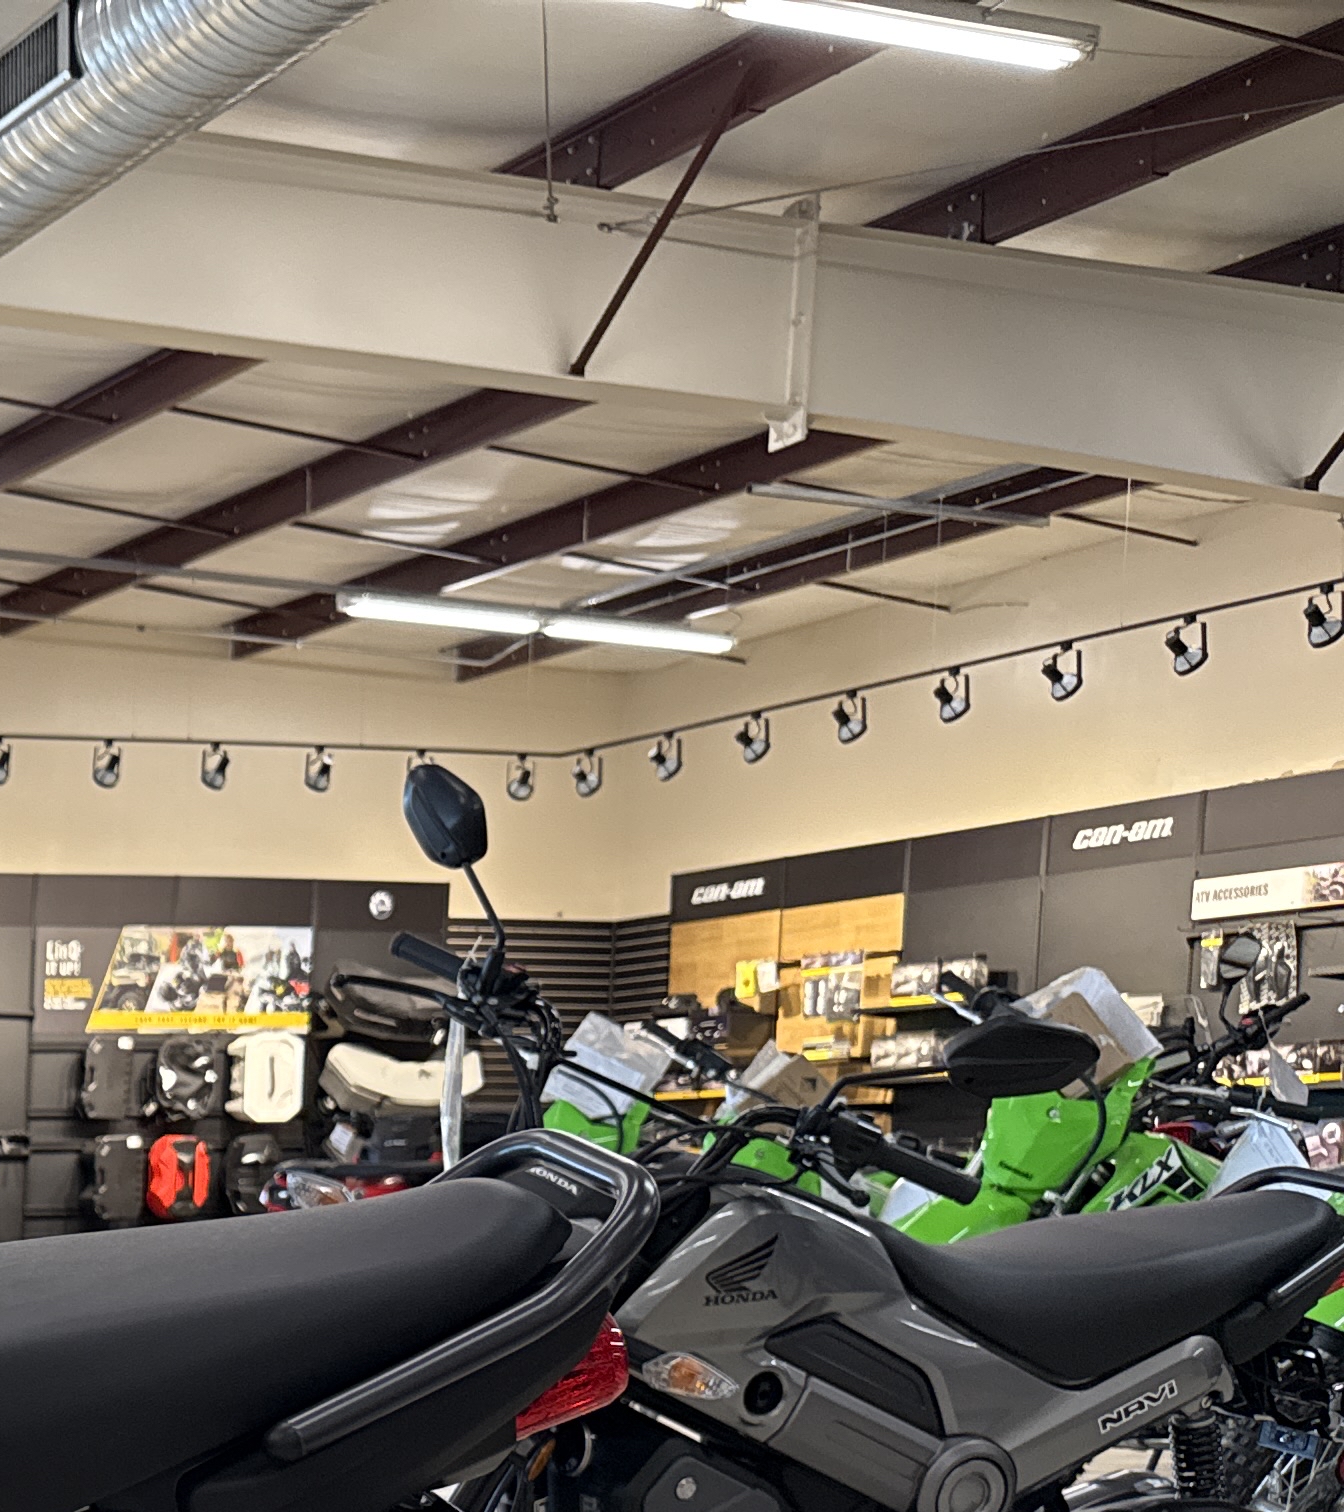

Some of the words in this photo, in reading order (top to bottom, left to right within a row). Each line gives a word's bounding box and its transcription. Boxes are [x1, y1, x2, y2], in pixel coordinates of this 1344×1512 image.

[1072, 817, 1173, 850] can-am
[1196, 890, 1210, 903] ATV
[1212, 883, 1269, 901] ACCESSORIES
[703, 1289, 779, 1306] HONDA
